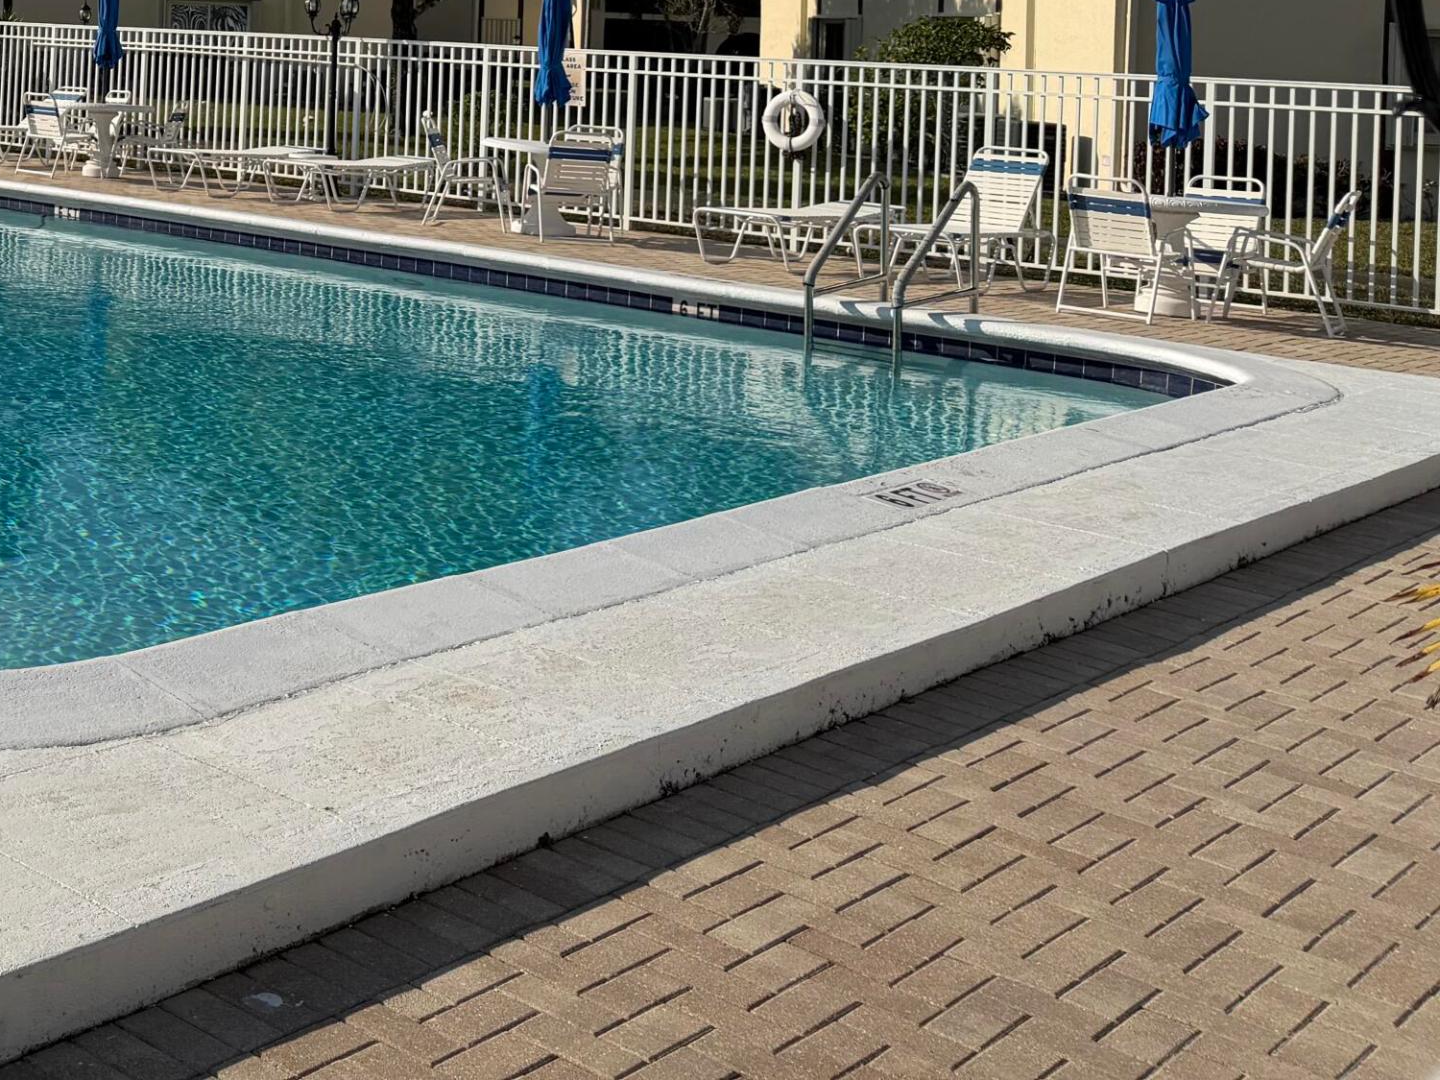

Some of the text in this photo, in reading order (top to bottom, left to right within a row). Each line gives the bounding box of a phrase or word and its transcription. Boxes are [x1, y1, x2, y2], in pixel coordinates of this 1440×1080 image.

[680, 300, 717, 320] 6 FT
[875, 487, 942, 507] 6 FT
